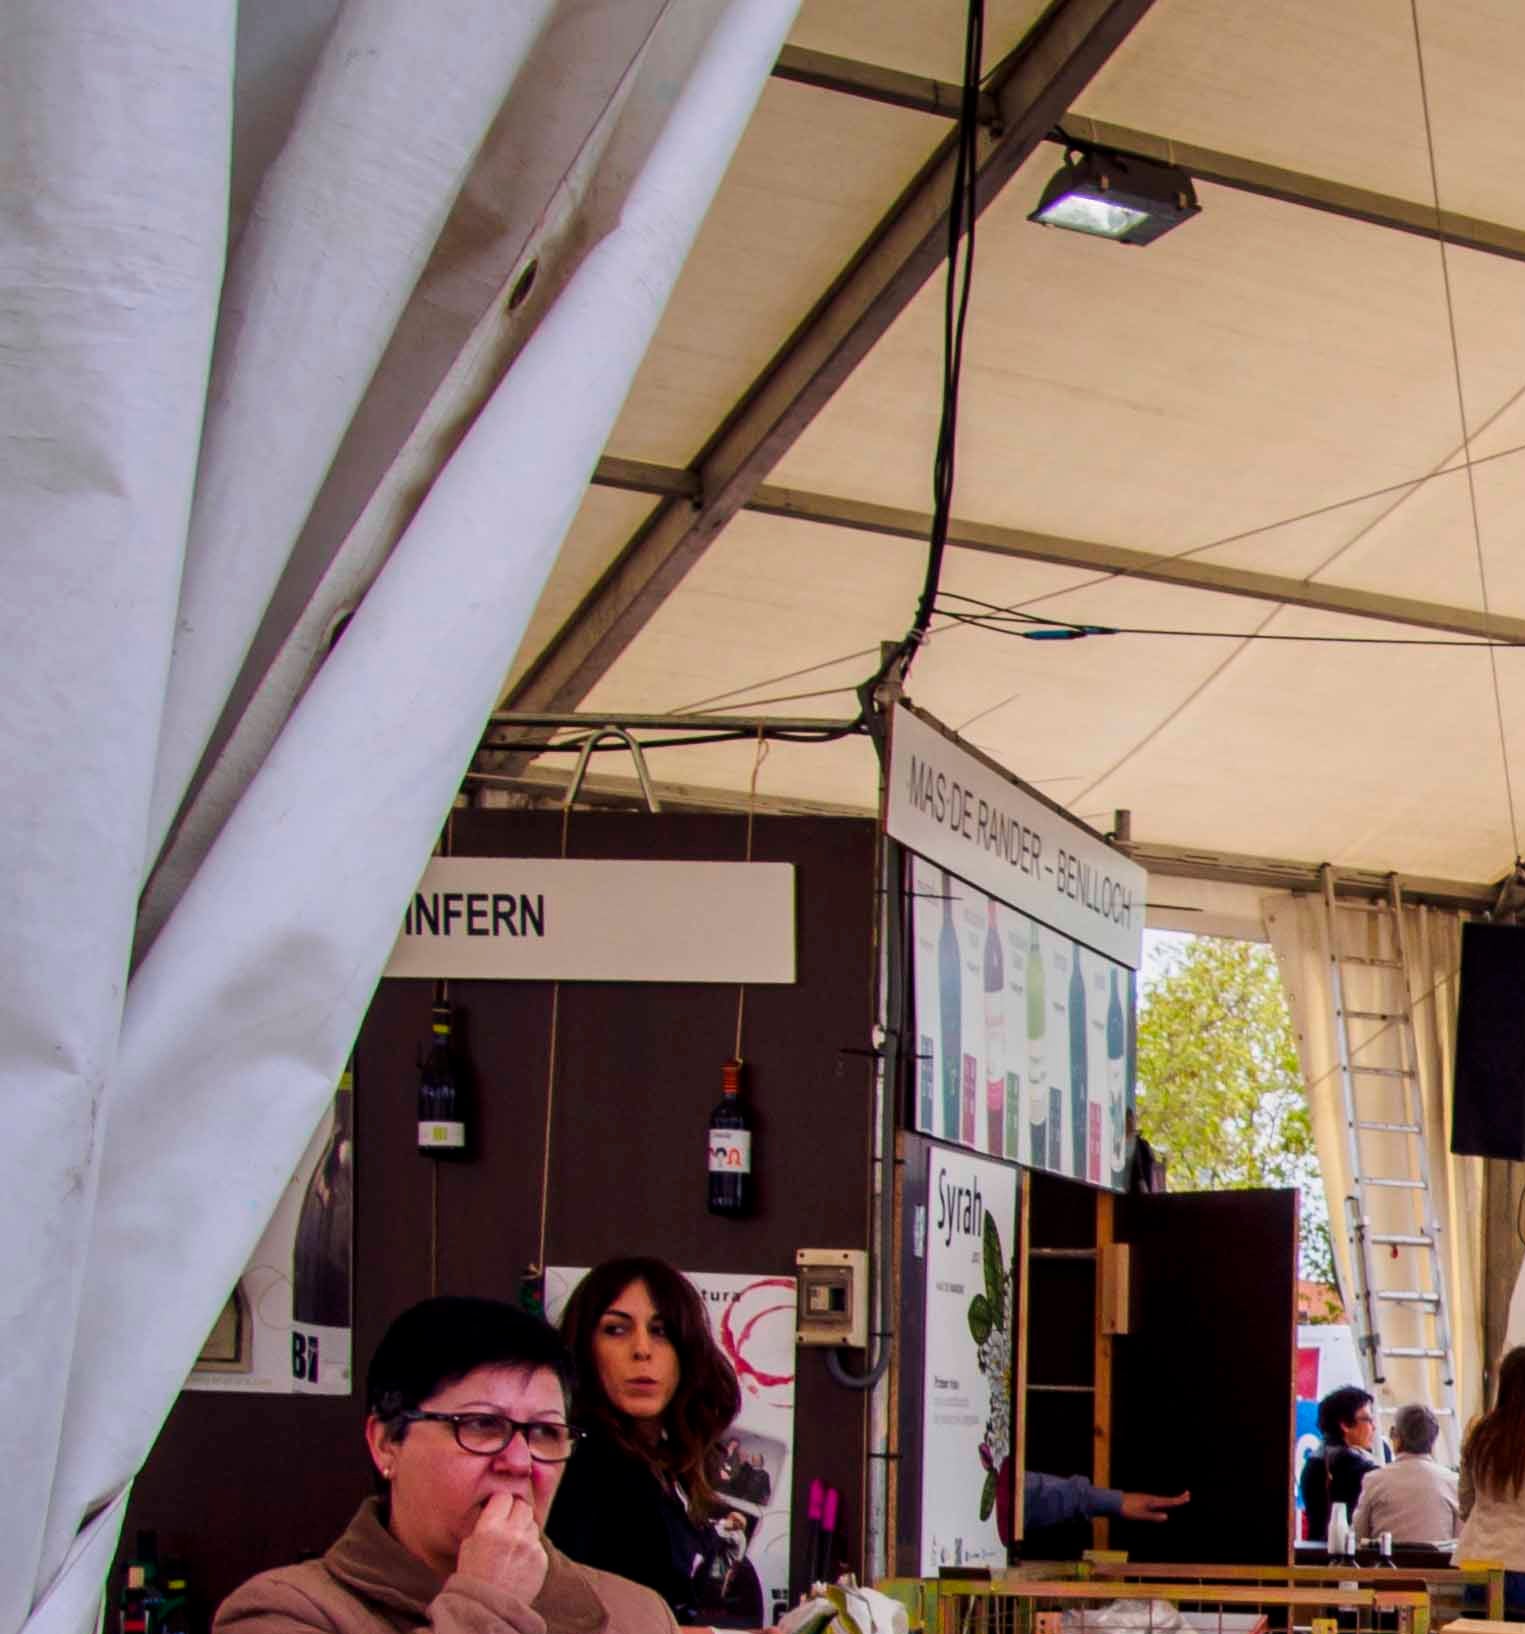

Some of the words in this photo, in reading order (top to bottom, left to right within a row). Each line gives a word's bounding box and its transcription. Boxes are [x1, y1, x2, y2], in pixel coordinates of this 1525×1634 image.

[909, 754, 945, 823] MAS
[950, 782, 974, 840] DE
[977, 800, 1041, 881] RANDER
[1057, 850, 1132, 930] BENLLOCH
[938, 1168, 982, 1247] Syrah
